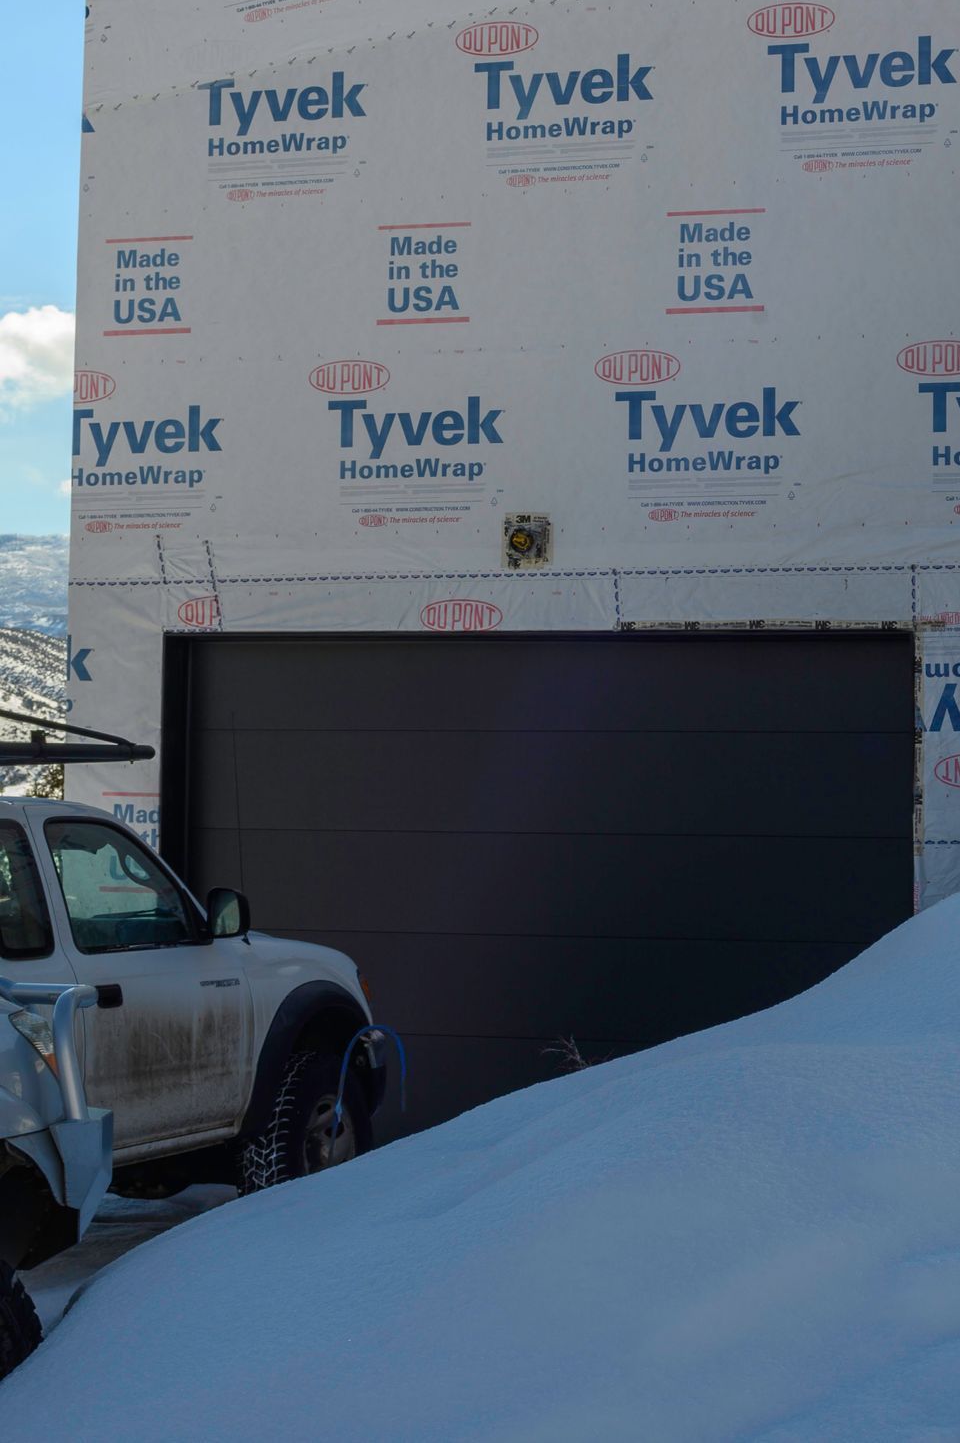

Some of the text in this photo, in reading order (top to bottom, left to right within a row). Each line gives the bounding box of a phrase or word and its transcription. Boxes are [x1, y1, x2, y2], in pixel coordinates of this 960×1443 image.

[768, 36, 956, 103] Tyvek
[475, 54, 654, 120] Tyvek
[198, 71, 366, 136] Tyvek
[781, 101, 935, 125] HomeWrap
[487, 117, 633, 140] HomeWrap
[208, 133, 347, 156] HomeWrap
[680, 223, 751, 244] Made
[390, 236, 458, 256] Made
[678, 248, 752, 267] in the
[116, 250, 180, 269] Made
[389, 259, 458, 279] in the
[115, 273, 181, 291] in the
[677, 273, 753, 301] USA
[114, 297, 182, 324] USA
[387, 285, 460, 313] USA
[328, 396, 503, 459] Tyvek
[615, 388, 800, 451] Tyvek
[340, 459, 483, 481] HomeWrap
[628, 451, 779, 474] HomeWrap
[72, 466, 203, 487] HomeWrap
[516, 515, 531, 523] 3M
[114, 803, 160, 823] Mad
